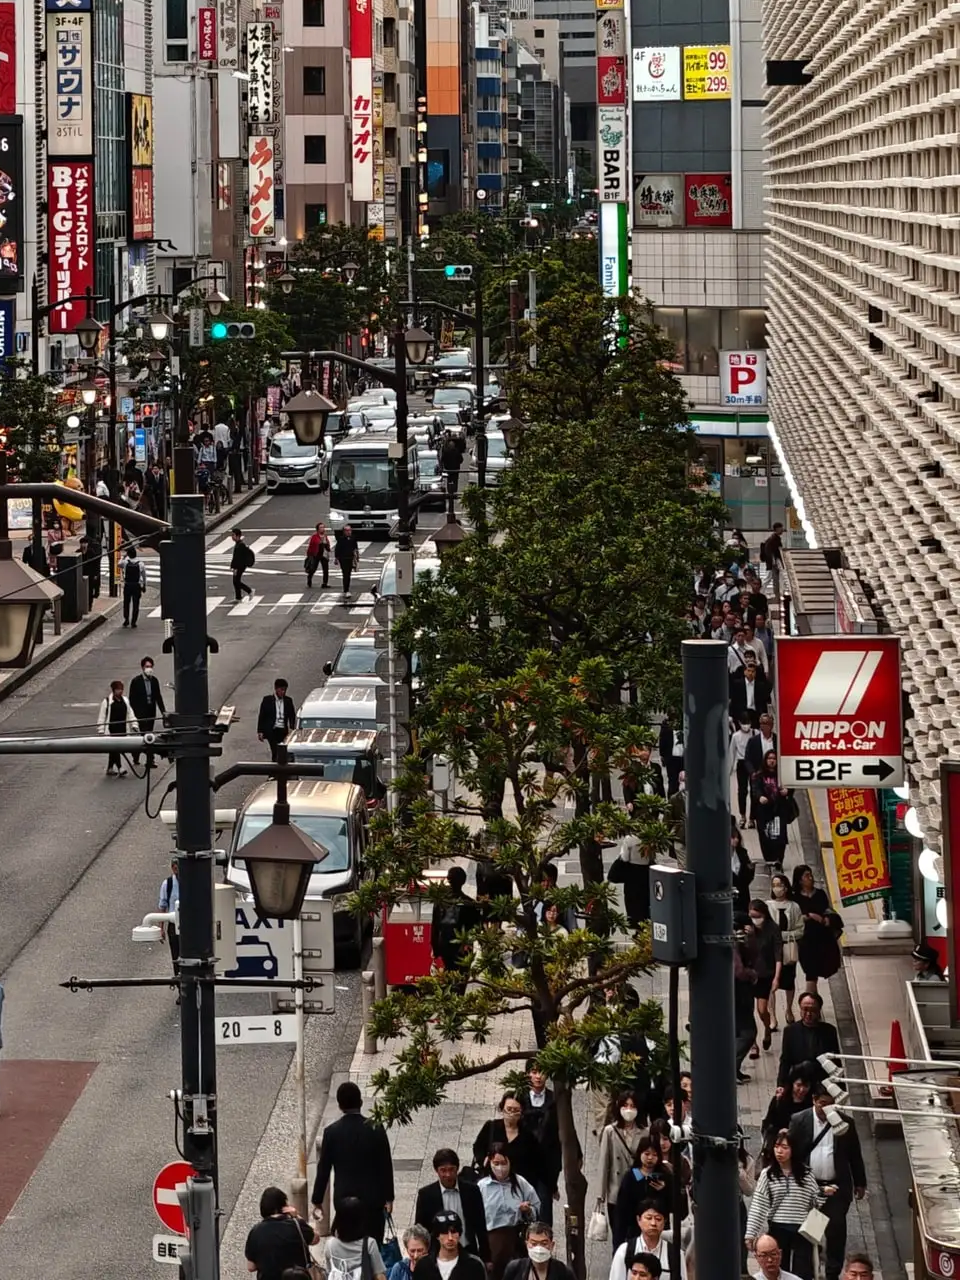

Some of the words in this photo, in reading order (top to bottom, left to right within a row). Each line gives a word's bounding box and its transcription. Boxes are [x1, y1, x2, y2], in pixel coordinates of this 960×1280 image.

[202, 50, 213, 59] 5F
[634, 51, 646, 61] 4F
[709, 51, 726, 70] 99
[58, 45, 82, 120] サウナ
[248, 25, 260, 122] スープ専門店
[260, 24, 271, 122] 濃厚とんこつ
[686, 83, 707, 94] 生ビール
[707, 76, 727, 93] 299
[353, 95, 371, 164] カラオケ
[603, 150, 620, 190] BAR
[249, 137, 273, 236] ラーメン
[604, 192, 620, 200] B1F
[75, 166, 89, 271] パチンコ・スロット
[603, 256, 616, 295] Family
[729, 354, 757, 366] 地下
[730, 367, 756, 395] P
[724, 395, 763, 405] 30m手前
[794, 720, 886, 739] NIPPON
[800, 739, 876, 751] Rent-A-Car
[795, 759, 852, 781] B2F
